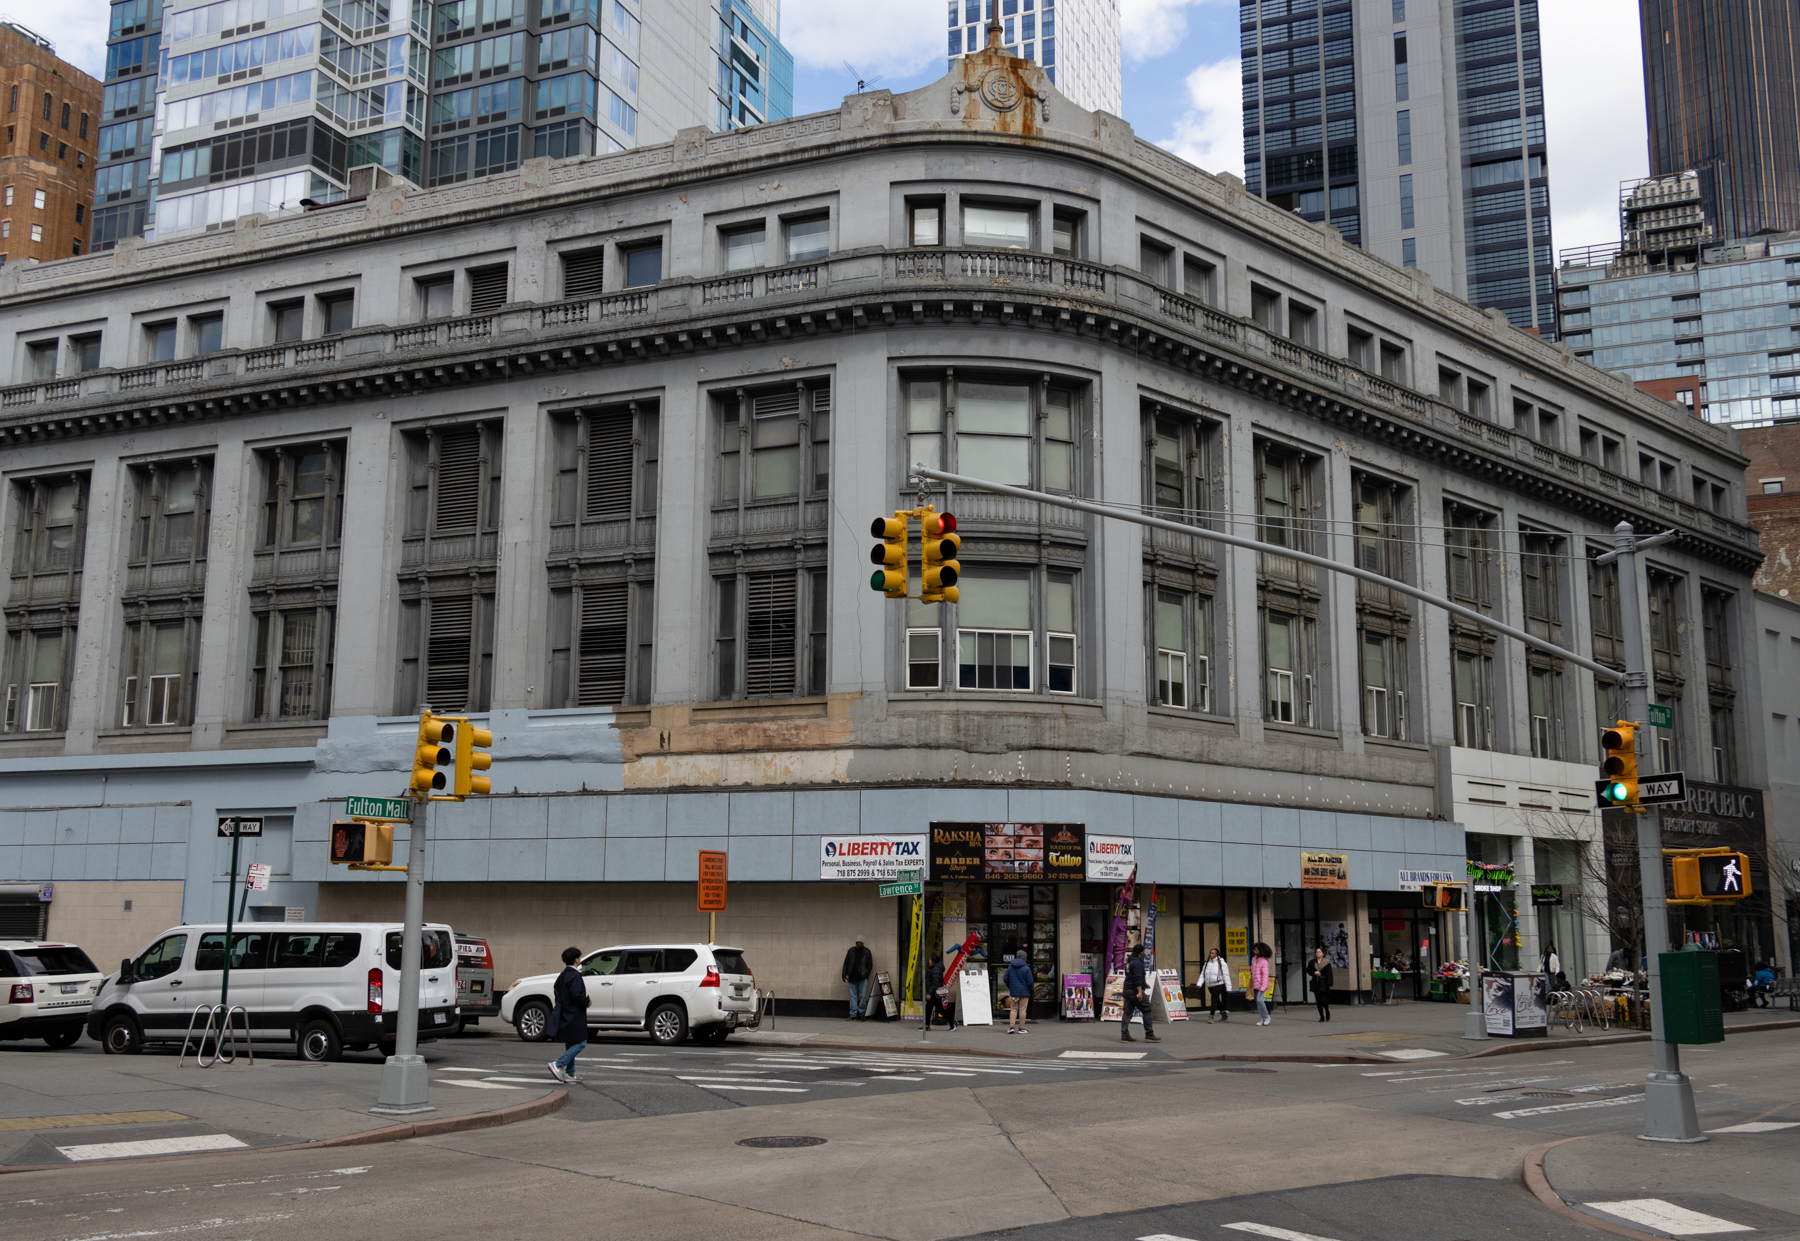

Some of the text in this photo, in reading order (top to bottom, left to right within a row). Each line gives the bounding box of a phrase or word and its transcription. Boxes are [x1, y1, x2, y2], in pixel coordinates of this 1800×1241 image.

[1648, 706, 1666, 724] ulton
[1646, 782, 1673, 796] WAY
[348, 798, 408, 818] Fulton Mall
[1686, 788, 1754, 818] REPUBLIC
[1664, 817, 1720, 836] FACTORY STORE
[934, 828, 982, 845] RAKSHA
[1400, 871, 1452, 882] ALL BRANDS FOR LESS
[880, 884, 912, 895] Lawrence
[458, 980, 466, 989] 24
